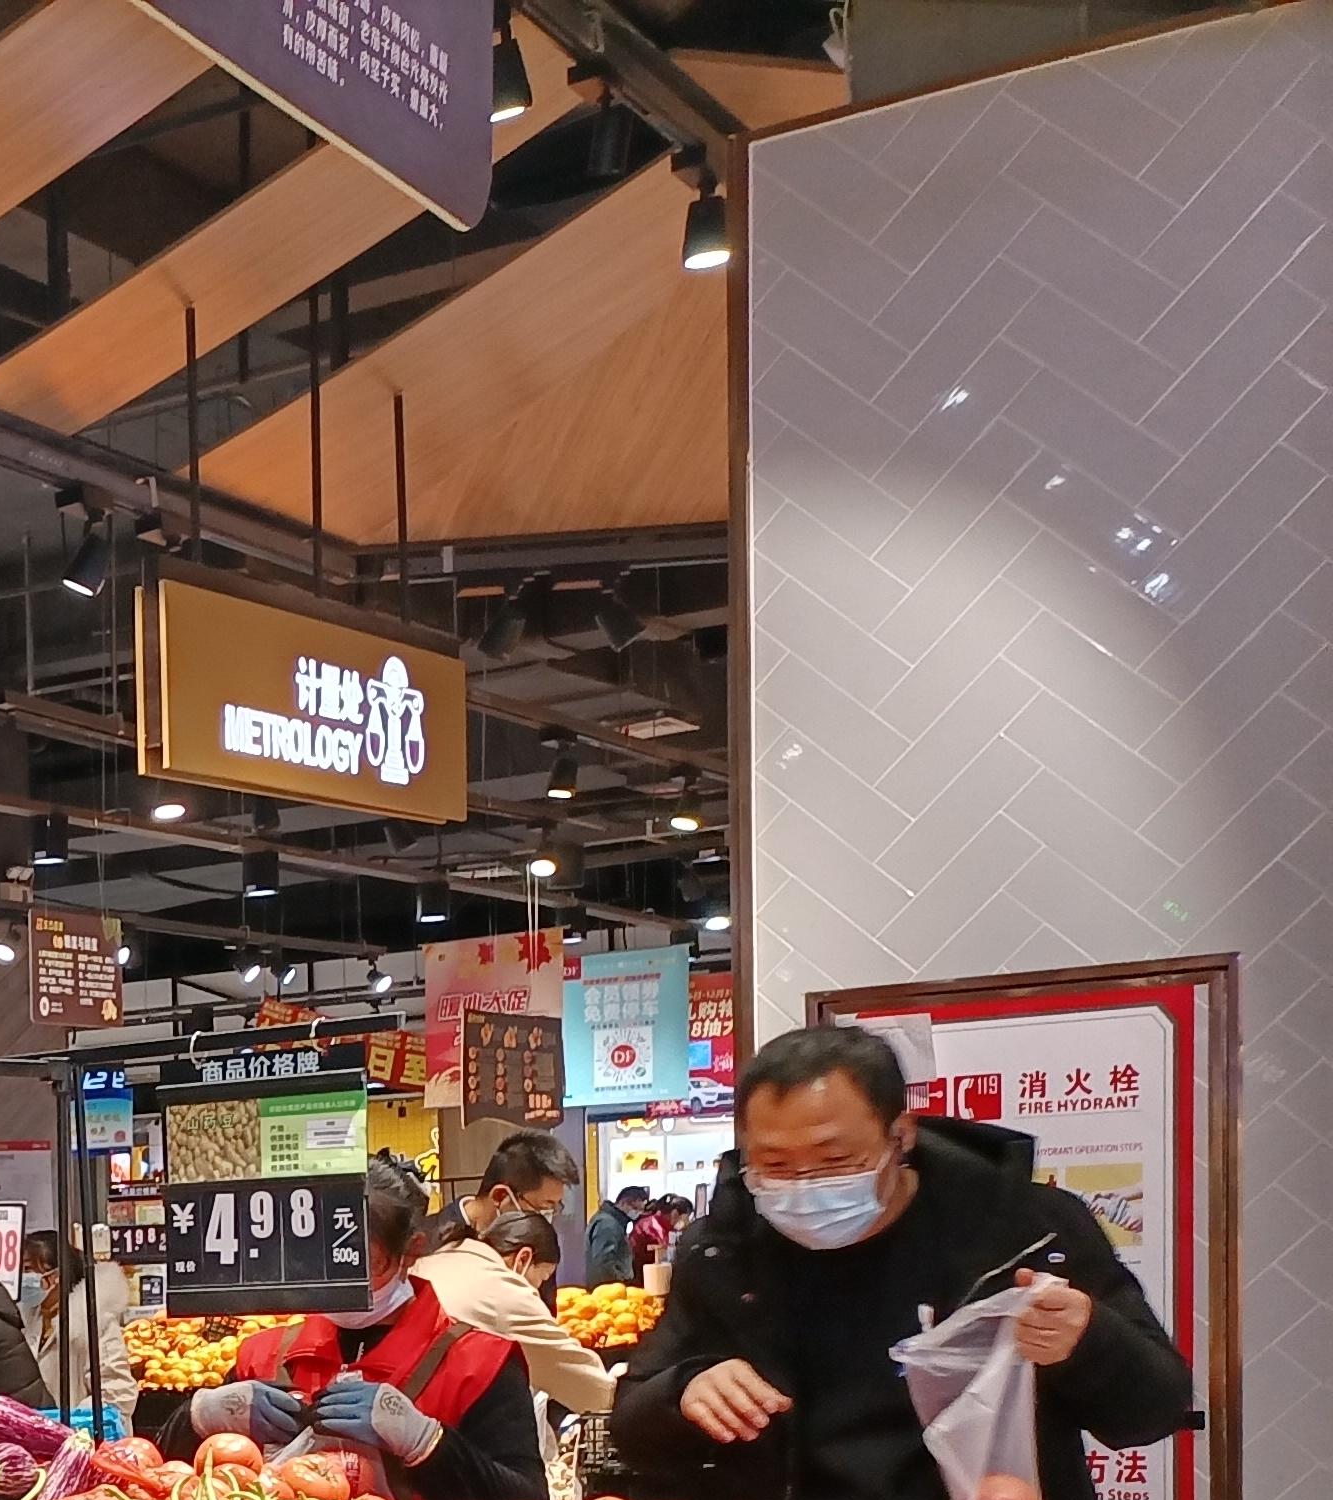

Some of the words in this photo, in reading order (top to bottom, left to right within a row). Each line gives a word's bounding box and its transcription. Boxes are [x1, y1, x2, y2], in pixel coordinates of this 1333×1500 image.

[224, 704, 363, 774] METROLOGY
[201, 1051, 319, 1082] 商品价格牌
[1018, 1064, 1140, 1099] 消火栓
[977, 1076, 998, 1095] 119
[1018, 1101, 1053, 1114] FIRE
[1057, 1095, 1140, 1112] HYDRANT
[205, 1189, 316, 1265] 4.98
[1085, 1450, 1147, 1484] 方法
